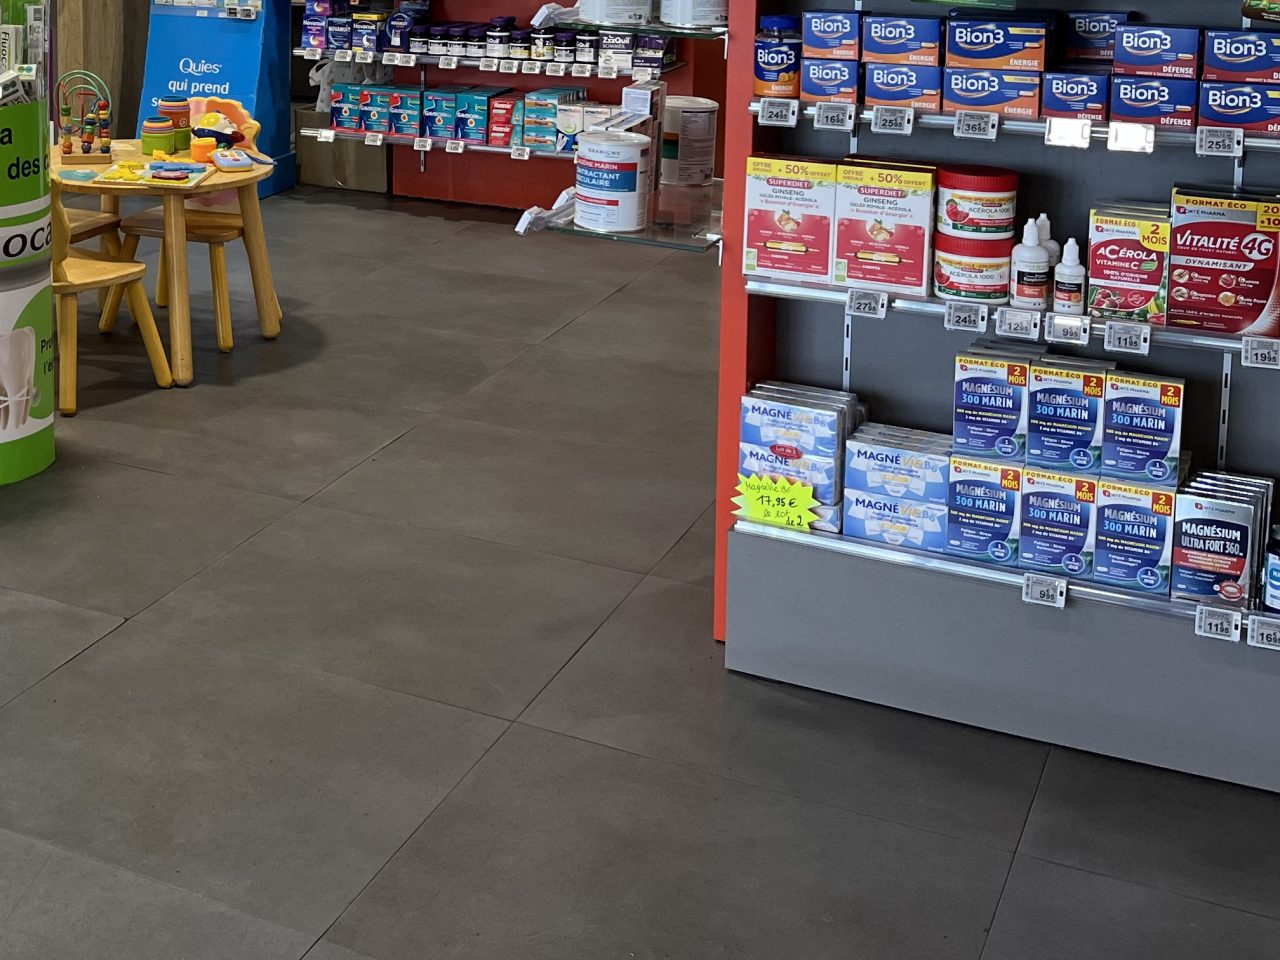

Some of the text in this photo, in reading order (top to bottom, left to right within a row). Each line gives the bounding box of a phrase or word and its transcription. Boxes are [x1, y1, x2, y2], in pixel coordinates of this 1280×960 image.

[811, 17, 851, 33] Bion3
[1122, 32, 1171, 50] Bion3
[757, 47, 795, 64] Bion3
[909, 53, 935, 62] ÉNERGIE
[180, 57, 222, 76] Quies
[1162, 65, 1194, 75] DÉFENSE
[168, 79, 230, 96] qui prend
[7, 157, 40, 180] des
[594, 161, 618, 170] MARIN
[785, 164, 809, 176] 50%
[768, 178, 810, 189] SUPERDIET
[772, 188, 805, 197] GINSENG
[1185, 198, 1247, 210] FORMAT ÉCO
[1150, 224, 1160, 235] 2
[1142, 235, 1167, 246] MOIS
[1176, 230, 1239, 251] VITALITÉ
[1242, 237, 1275, 257] 4G
[1096, 245, 1157, 261] ACÉROLA
[1096, 259, 1139, 270] VITAMINE C
[1185, 258, 1249, 270] DYNAMISANT
[1036, 391, 1089, 408] MAGNÉSIUM
[751, 404, 792, 420] MAGNÉ
[1036, 404, 1088, 420] 300 MARIN
[789, 498, 798, 508] €
[1182, 522, 1241, 541] MAGNÉSIUM
[1181, 538, 1240, 556] ULTRA FORT 360
